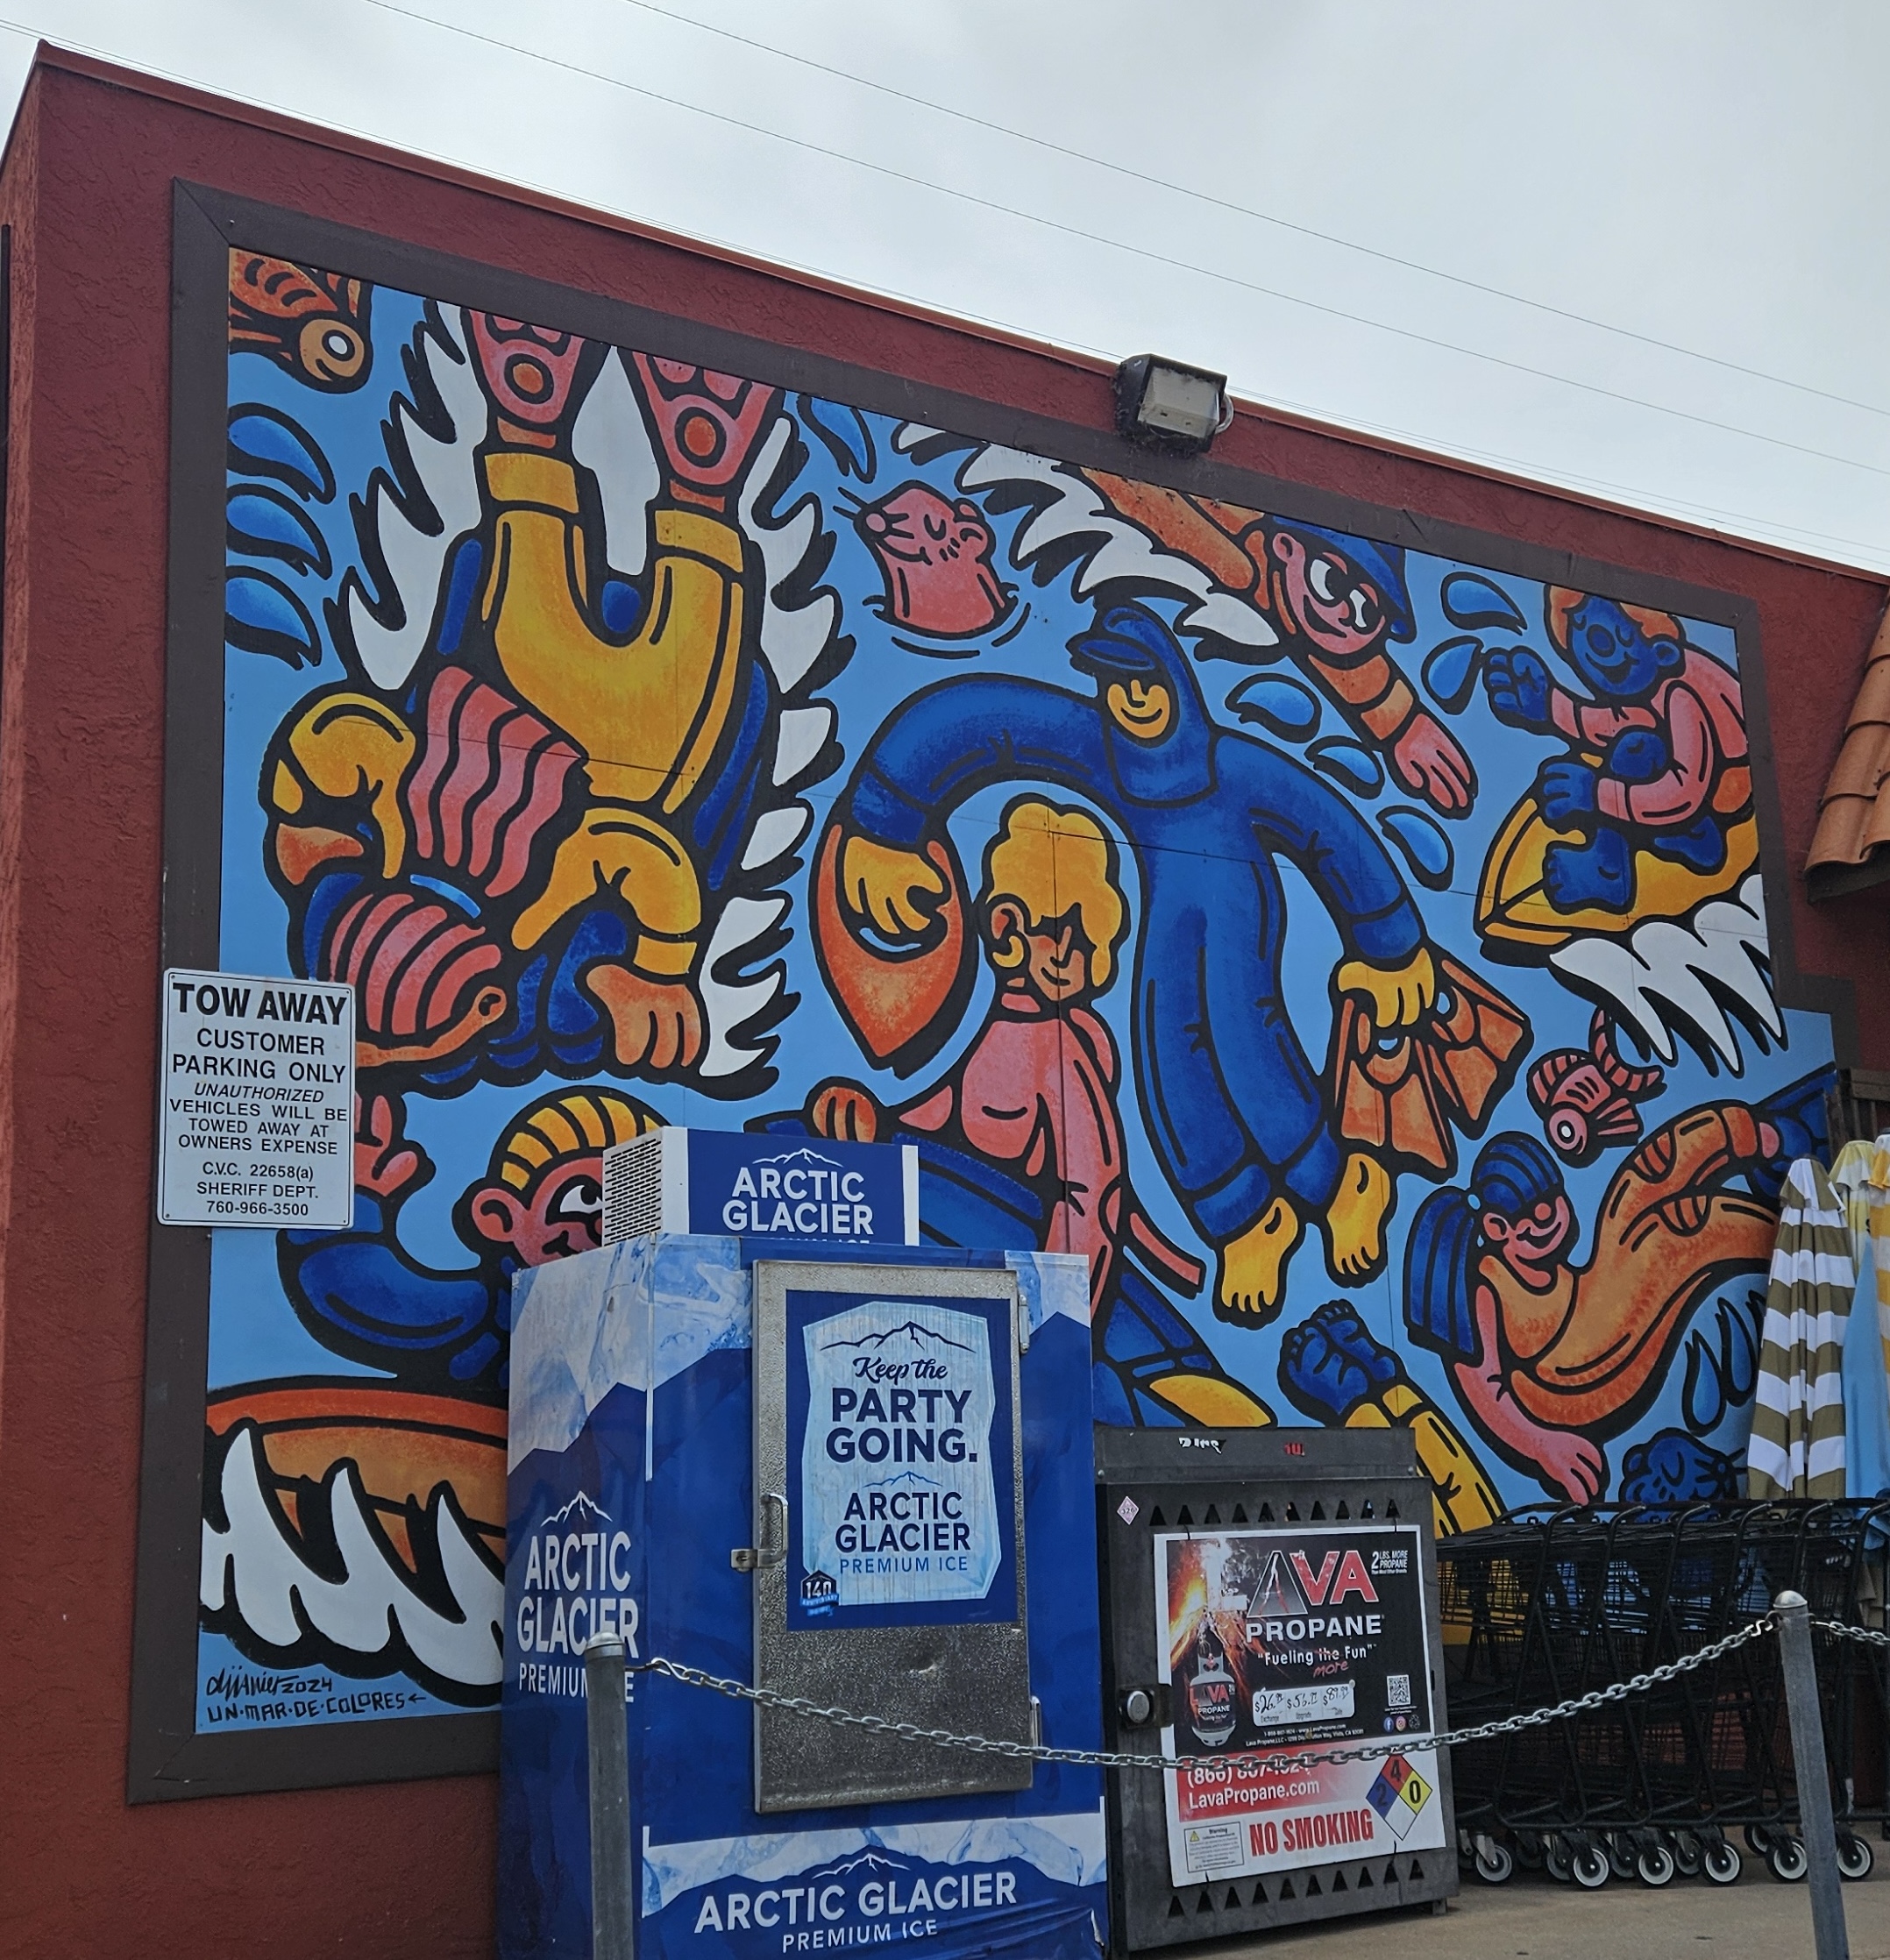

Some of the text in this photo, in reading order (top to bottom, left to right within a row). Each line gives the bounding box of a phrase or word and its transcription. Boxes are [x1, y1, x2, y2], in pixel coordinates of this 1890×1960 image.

[173, 983, 347, 1026] TOW AWAY
[196, 1028, 324, 1055] CUSTOMER
[173, 1054, 346, 1083] PARKING ONLY
[194, 1083, 323, 1103] UNAUTHORIZED
[169, 1098, 347, 1122] VEHICLES WILL BE
[188, 1118, 329, 1138] TOWED AWAY AT
[178, 1135, 338, 1155] OWNERS EXPENSE
[202, 1161, 314, 1182] C.V.C. 22658(a)
[732, 1167, 865, 1203] ARCTIC
[196, 1182, 318, 1198] SHERIFF DEPT.
[206, 1201, 309, 1217] 760-966-3500
[722, 1199, 874, 1235] GLACIER
[852, 1356, 948, 1385] Keep the
[833, 1388, 972, 1424] PARTY
[826, 1427, 977, 1463] GOING.
[844, 1491, 963, 1521] ARCTIC
[835, 1523, 970, 1553] GLACIER
[524, 1531, 631, 1592] ARCTIC
[840, 1556, 968, 1574] PREMIUM ICE
[1371, 1551, 1380, 1569] 2
[1391, 1550, 1408, 1559] MORE
[1379, 1559, 1408, 1569] PROPANE
[806, 1580, 832, 1599] 140
[517, 1596, 639, 1658] GLACIER
[1246, 1615, 1382, 1643] PROPANE
[1318, 1647, 1339, 1662] the
[1312, 1660, 1349, 1678] more
[281, 1676, 332, 1694] 2024
[1197, 1705, 1231, 1715] PROPANE
[1390, 1760, 1402, 1782] 4
[1189, 1780, 1320, 1810] LavaPropane.com
[1375, 1779, 1421, 1807] 2 0
[1249, 1822, 1279, 1857] NO
[1282, 1808, 1375, 1852] SMOKING
[694, 1871, 1018, 1934] ARCTIC GLACIER
[782, 1919, 938, 1953] PREMIUM ICE
